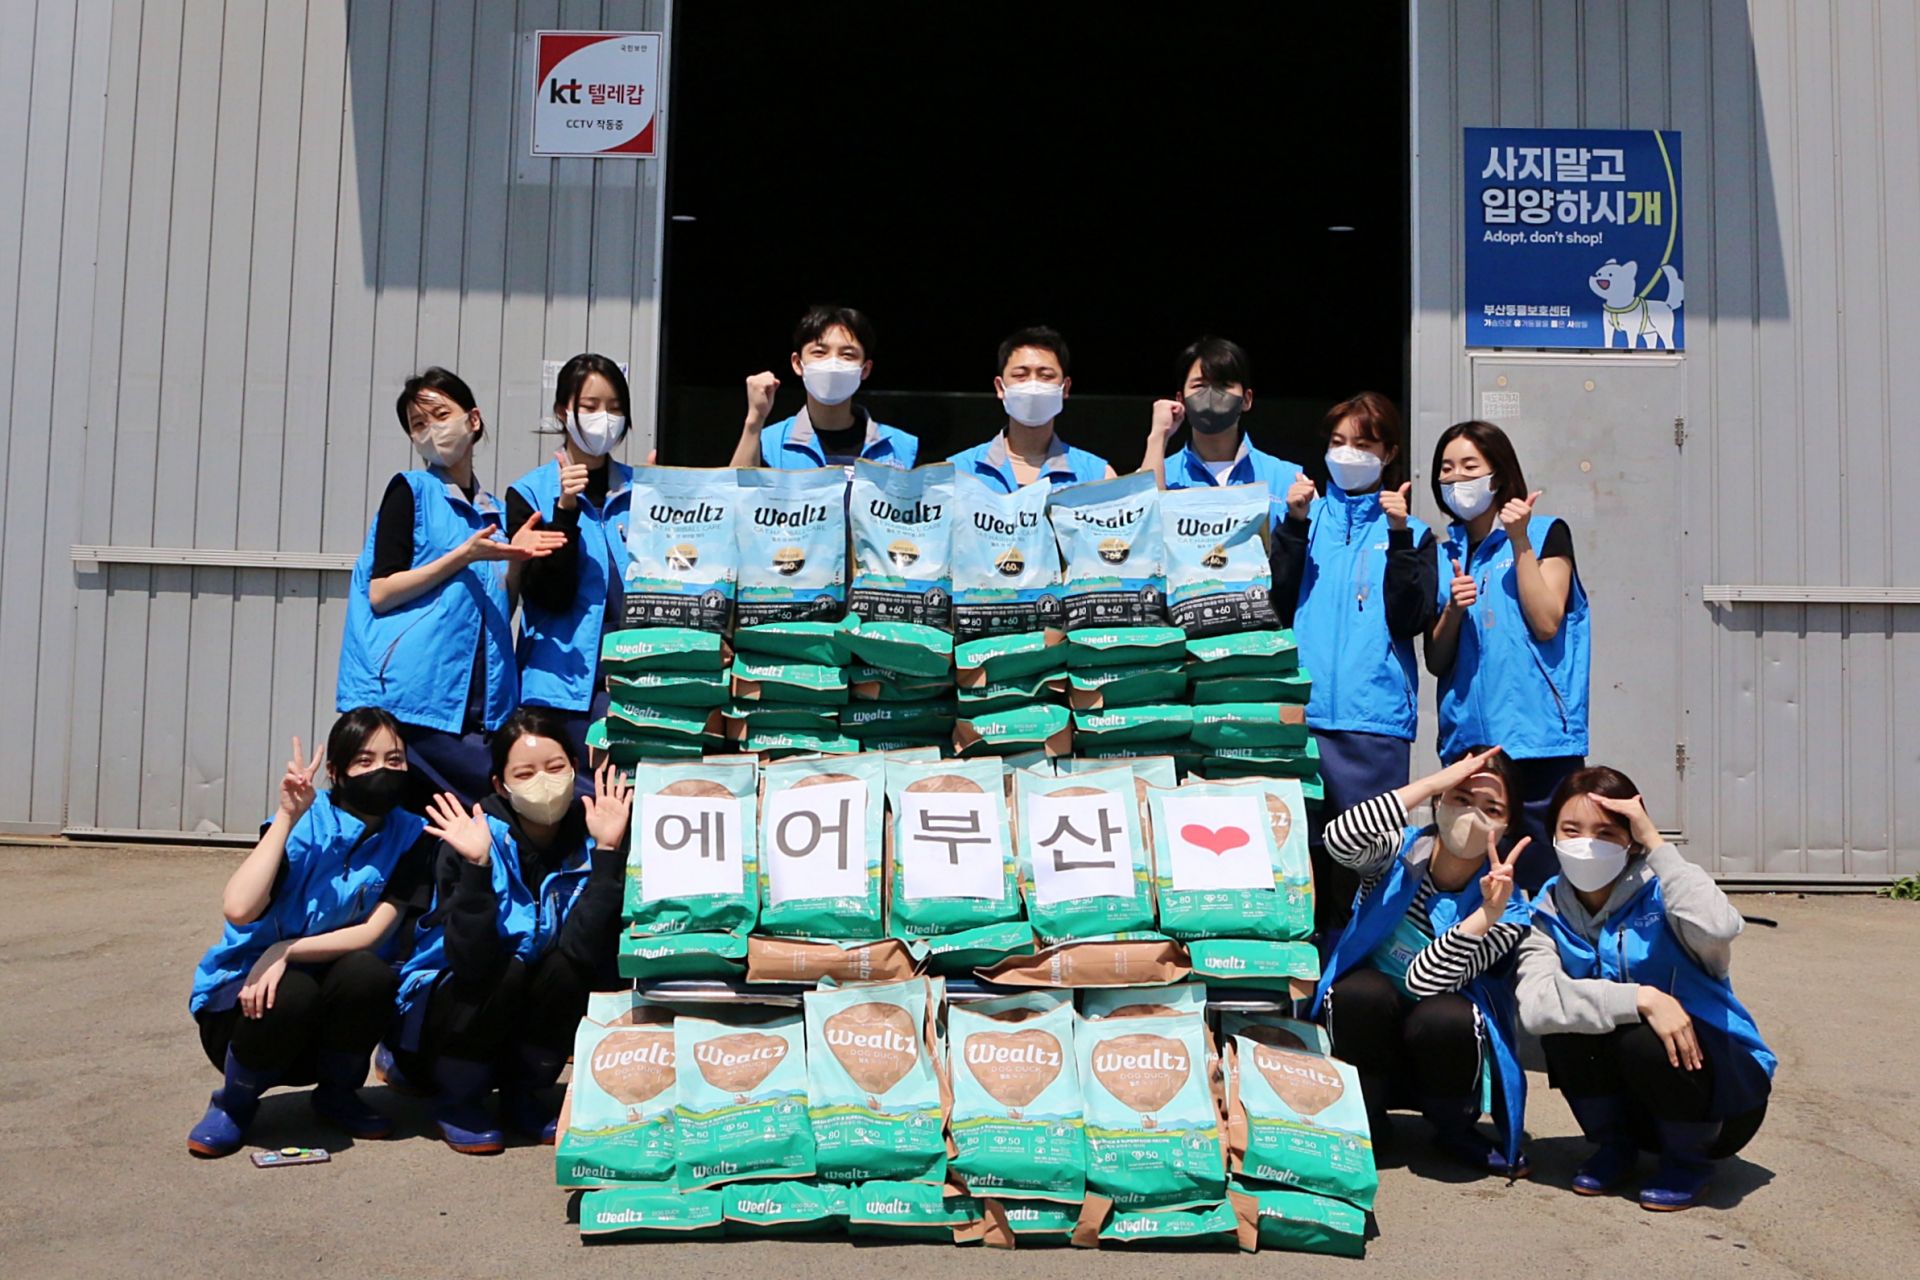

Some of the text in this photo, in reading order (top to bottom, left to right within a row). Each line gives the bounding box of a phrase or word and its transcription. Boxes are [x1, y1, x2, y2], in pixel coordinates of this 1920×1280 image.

[550, 78, 645, 105] kt 텔레캅
[566, 119, 624, 131] CCTV 작동중
[1482, 147, 1626, 182] 사지말고
[1482, 188, 1662, 226] 입양하시개
[1483, 231, 1603, 246] Adopt, don't shop!
[1484, 305, 1570, 317] 부산동물보호센터
[650, 502, 724, 524] Wealtz
[754, 504, 827, 527] Wealtz
[870, 500, 942, 524] Wealtz
[623, 704, 660, 720] Wealtz
[854, 709, 892, 722] Wealtz
[1088, 715, 1126, 726] Wealtz
[755, 734, 792, 746] Wealtz
[1205, 956, 1246, 969] Wealtz
[827, 1029, 918, 1058] Wealtz
[697, 1043, 786, 1067] Wealtz
[968, 1044, 1060, 1067] Wealtz
[1095, 1049, 1188, 1072] Wealtz
[1008, 1136, 1021, 1145] 50
[572, 1165, 616, 1178] Wealtz
[693, 1161, 738, 1178] Wealtz
[825, 1167, 870, 1180] Wealtz
[1256, 1164, 1300, 1185] Wealtz
[738, 1199, 782, 1214] Wealtz
[866, 1199, 911, 1214] Wealtz
[597, 1208, 644, 1224] Wealtz
[1114, 1217, 1159, 1232] Wealtz
